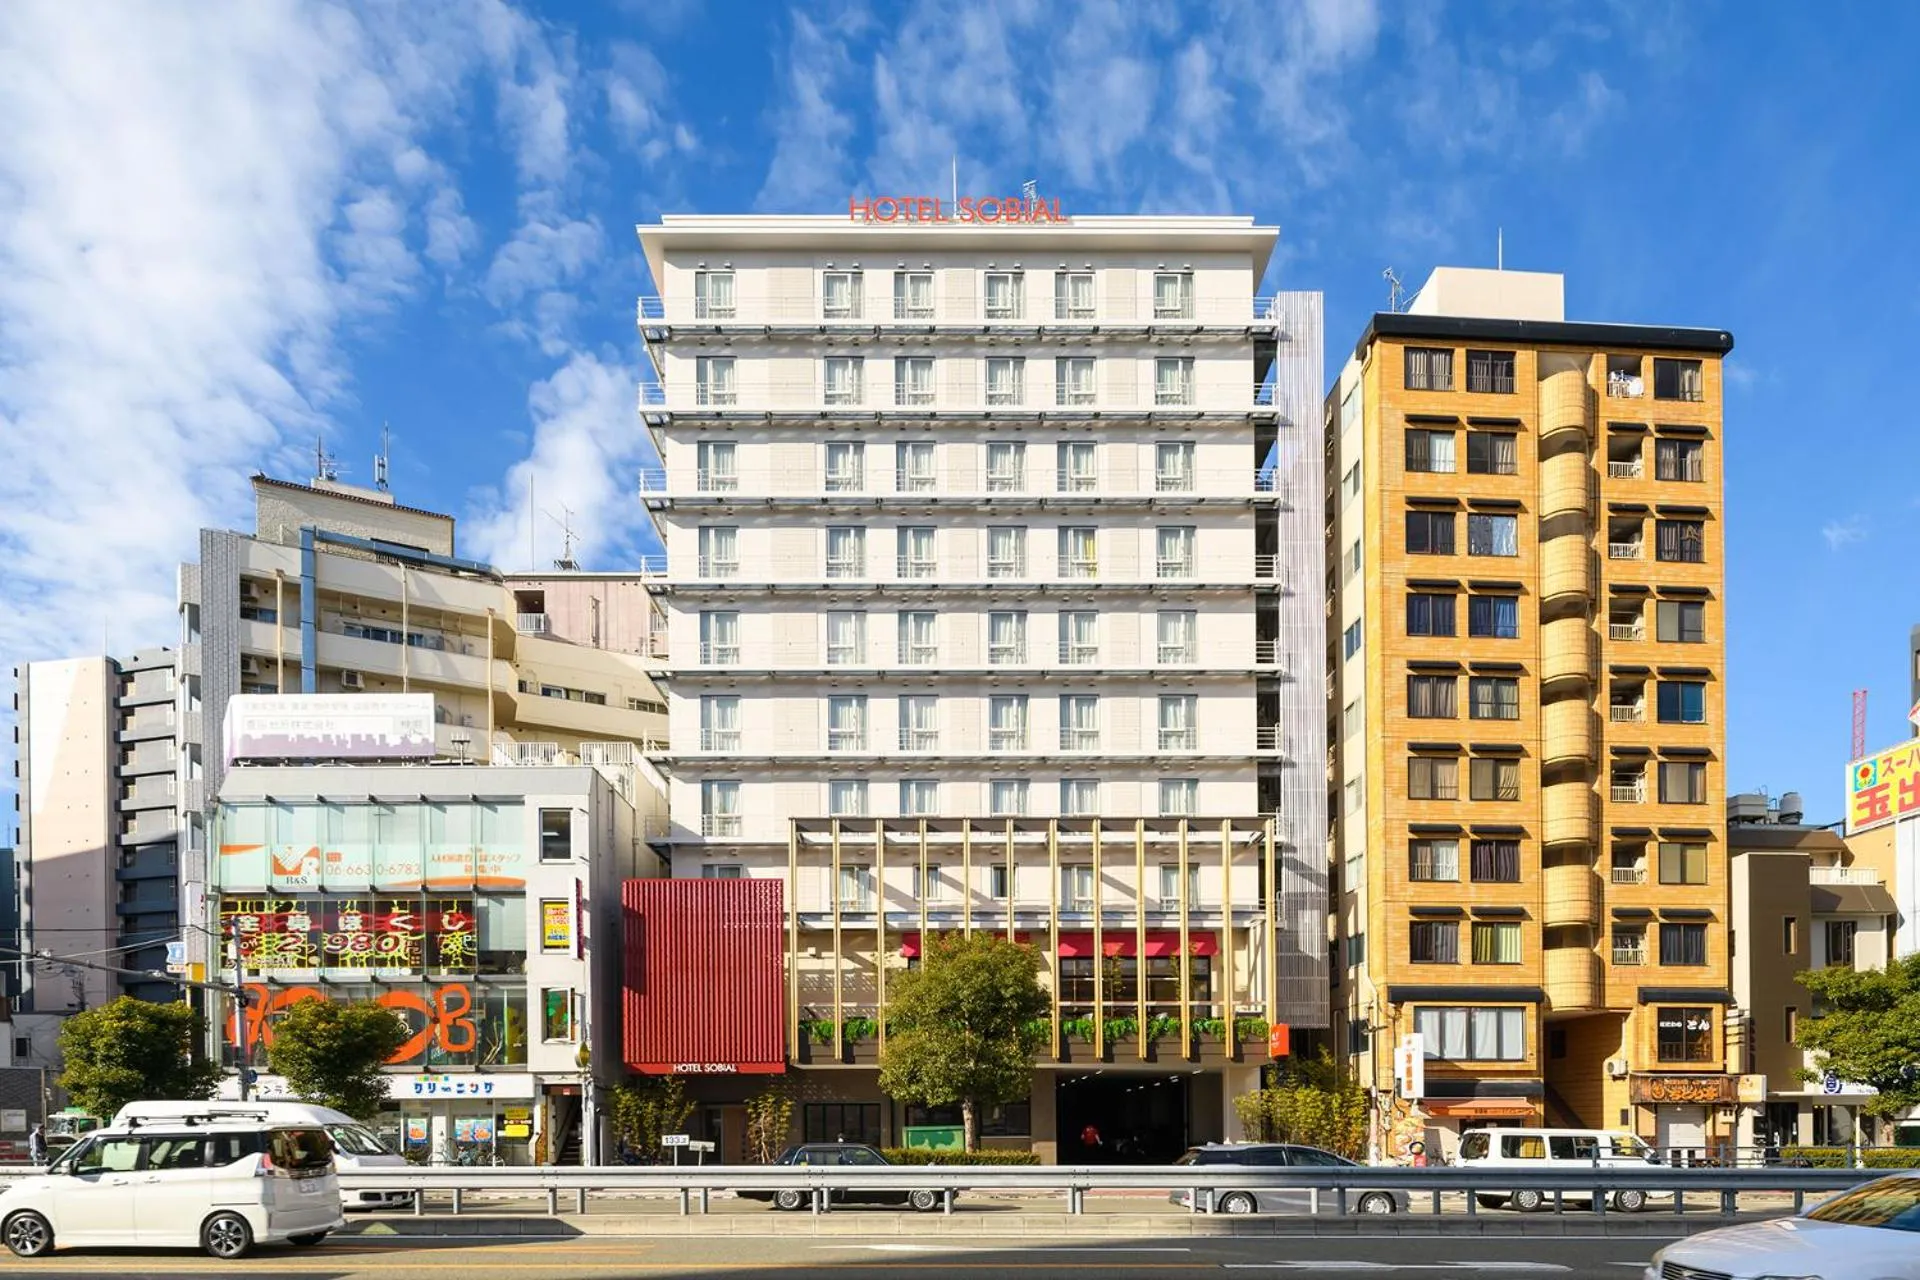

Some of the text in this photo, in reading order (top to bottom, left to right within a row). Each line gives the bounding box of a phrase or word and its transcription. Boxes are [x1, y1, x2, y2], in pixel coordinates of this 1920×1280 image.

[850, 197, 1068, 222] HOTEL SOBIAL
[674, 1063, 737, 1072] HOTEL SOBIAL
